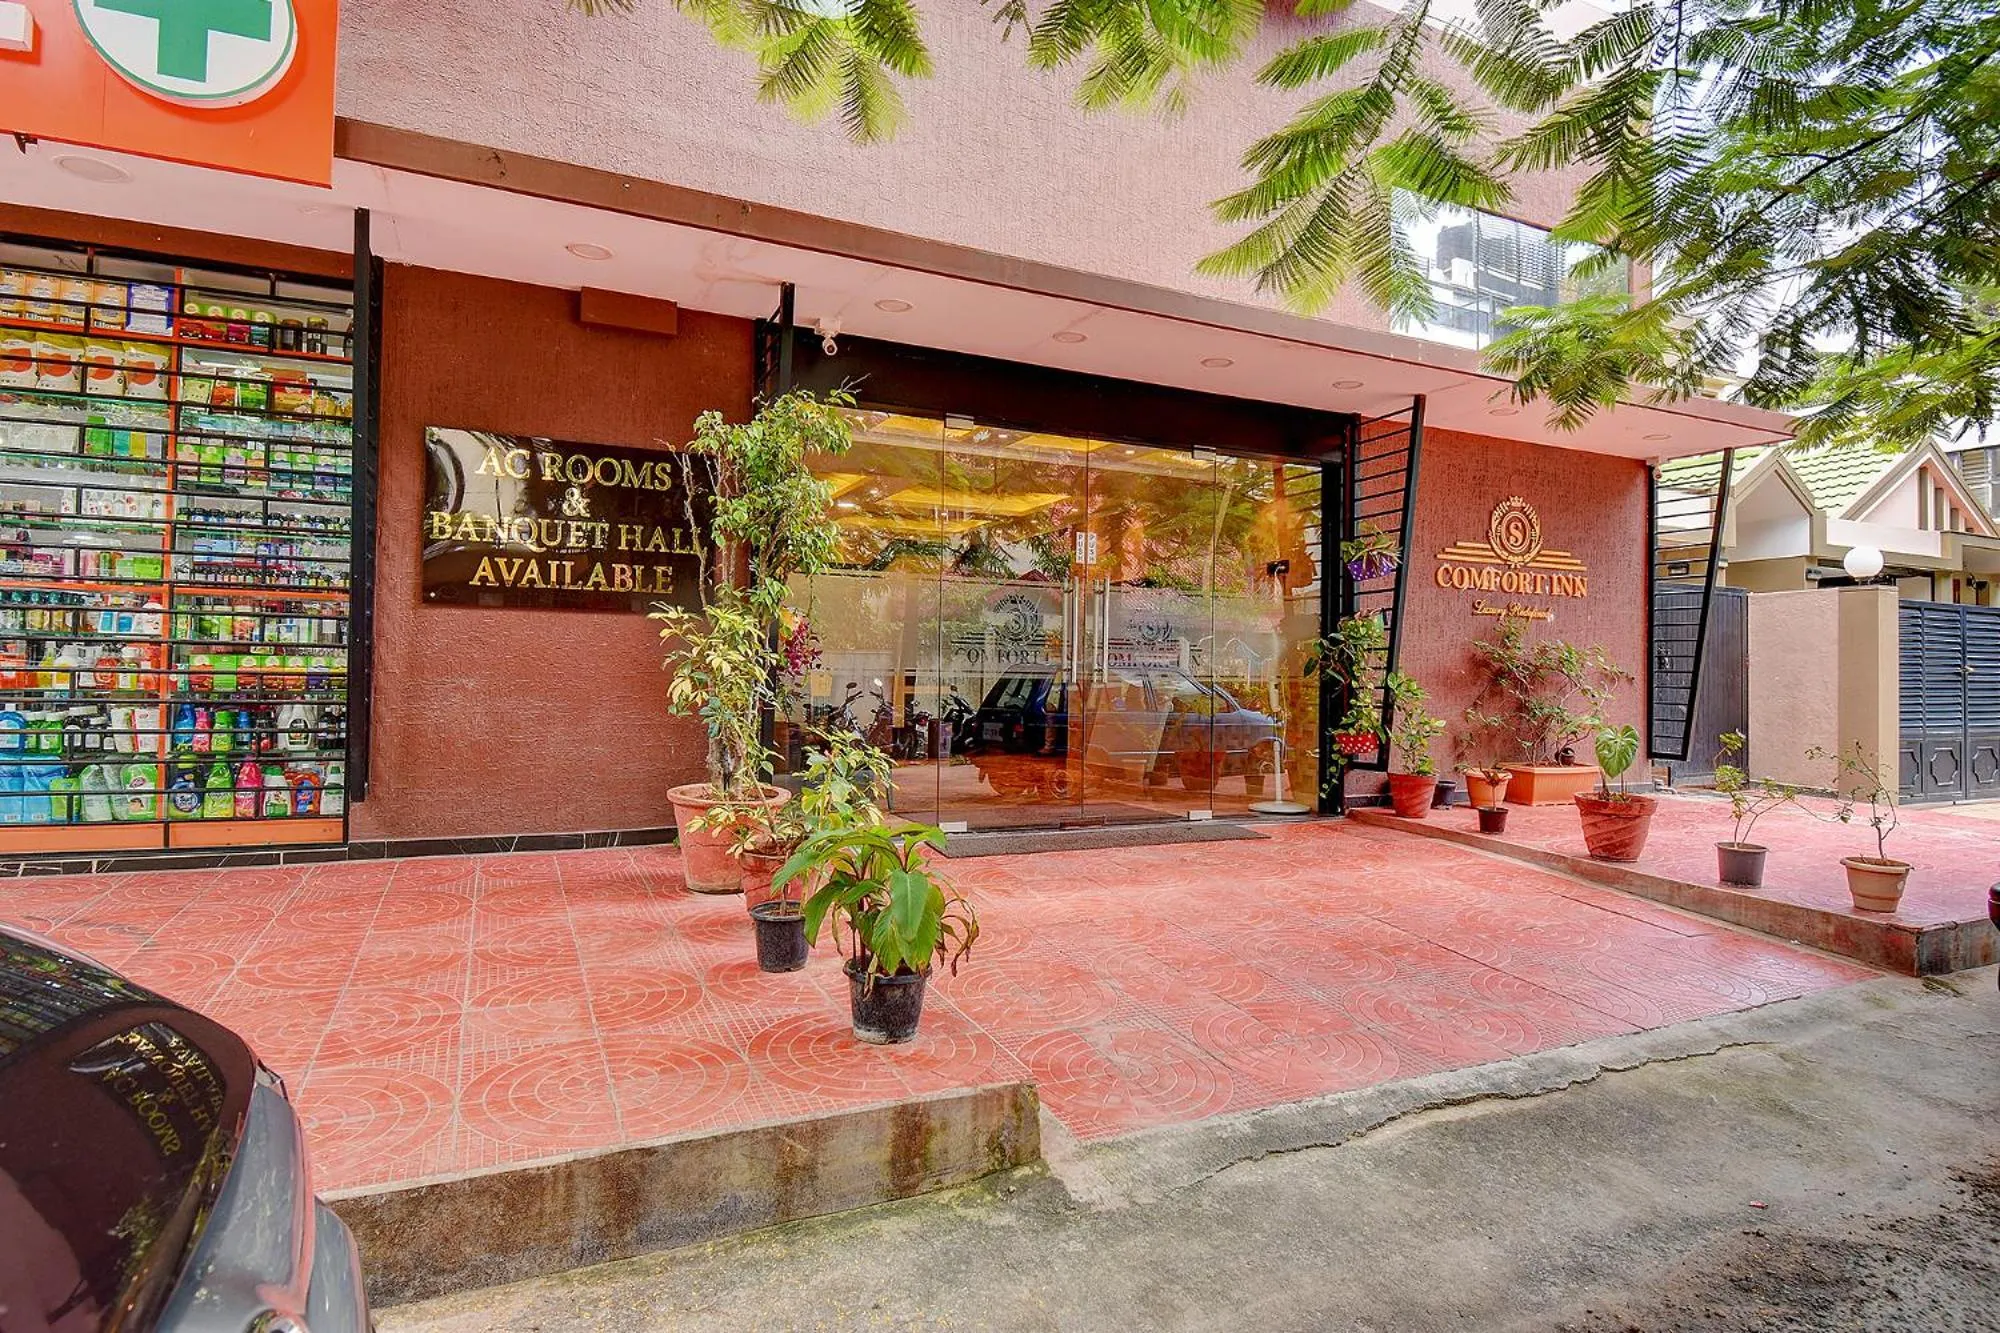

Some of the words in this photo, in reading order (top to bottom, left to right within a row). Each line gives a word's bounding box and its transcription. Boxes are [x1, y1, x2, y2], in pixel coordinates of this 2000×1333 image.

[475, 446, 531, 480] AC
[541, 452, 673, 492] ROOMS
[562, 487, 590, 518] &
[430, 510, 610, 553] BANQUET
[617, 523, 708, 555] HALL
[1508, 521, 1523, 546] S
[469, 555, 674, 595] AVAILABLE
[1436, 565, 1546, 595] COMFORT
[1551, 576, 1588, 598] INN
